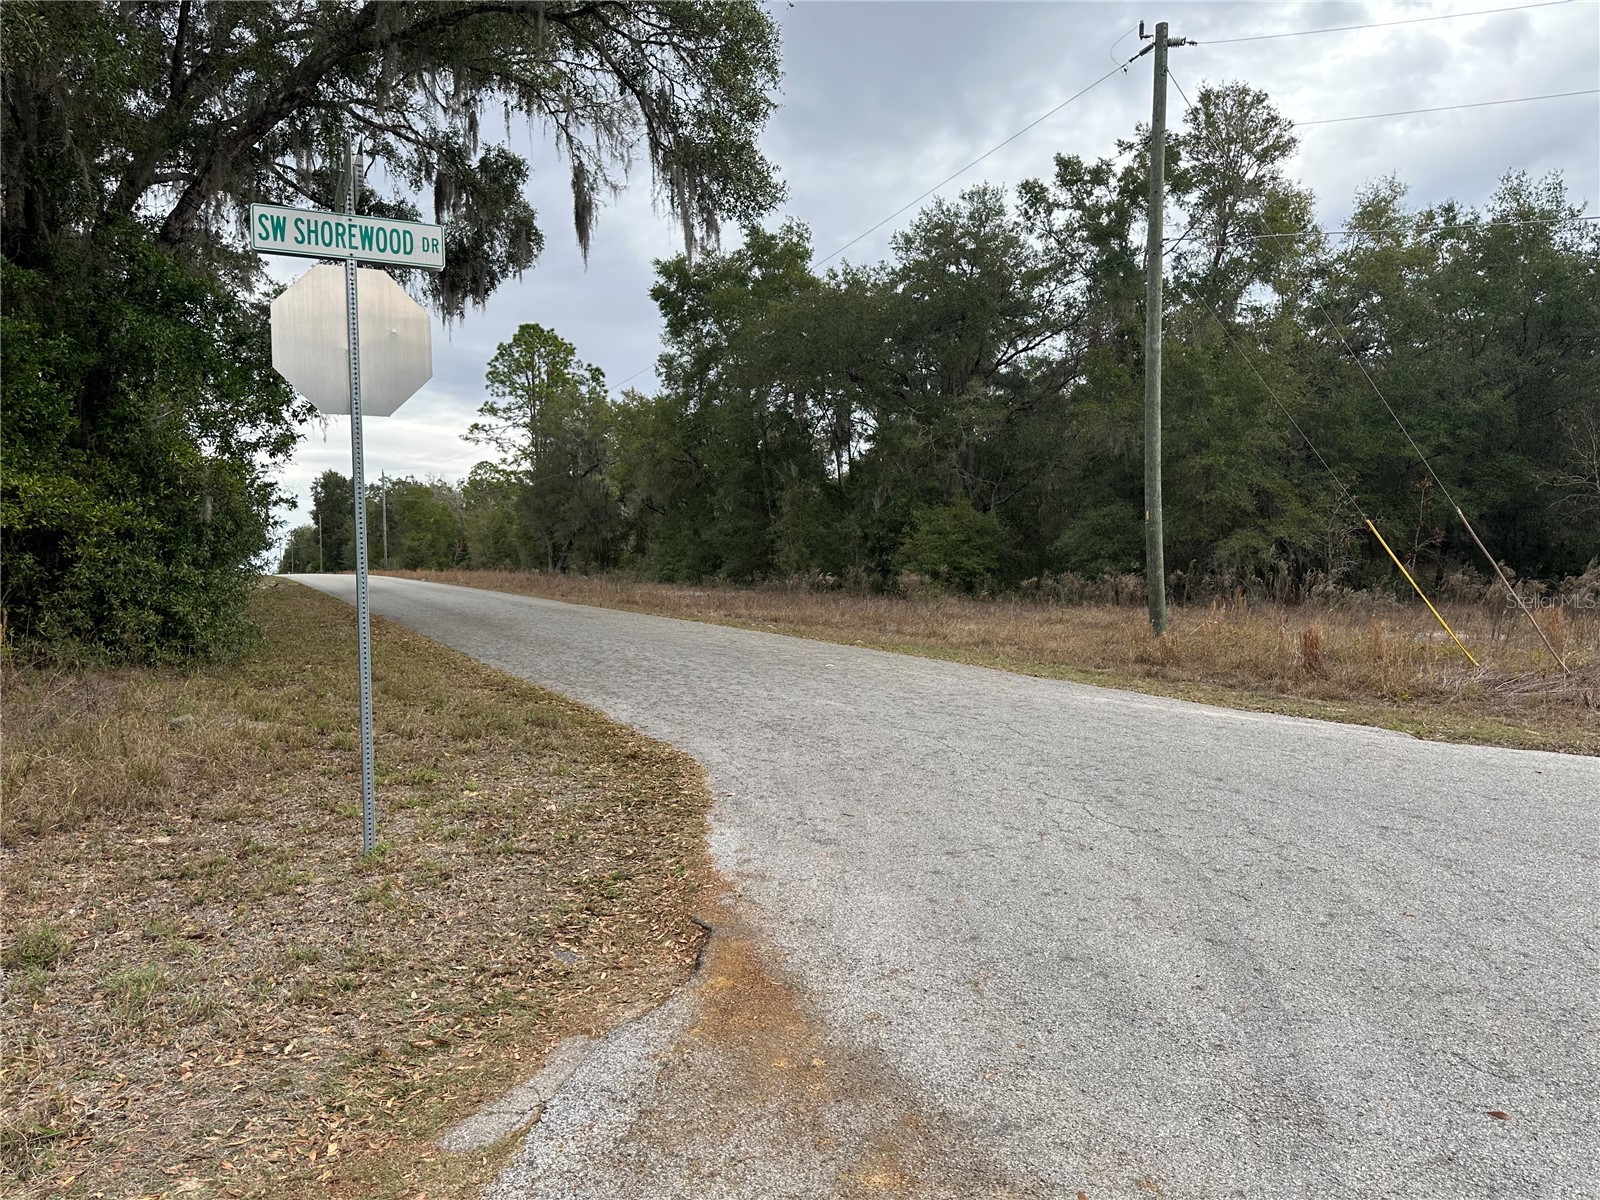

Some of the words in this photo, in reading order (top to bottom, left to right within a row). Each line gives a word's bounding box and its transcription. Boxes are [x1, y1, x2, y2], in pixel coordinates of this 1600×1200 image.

[258, 213, 286, 242] SW
[294, 217, 414, 255] SHOREWOOD
[422, 236, 439, 254] DR
